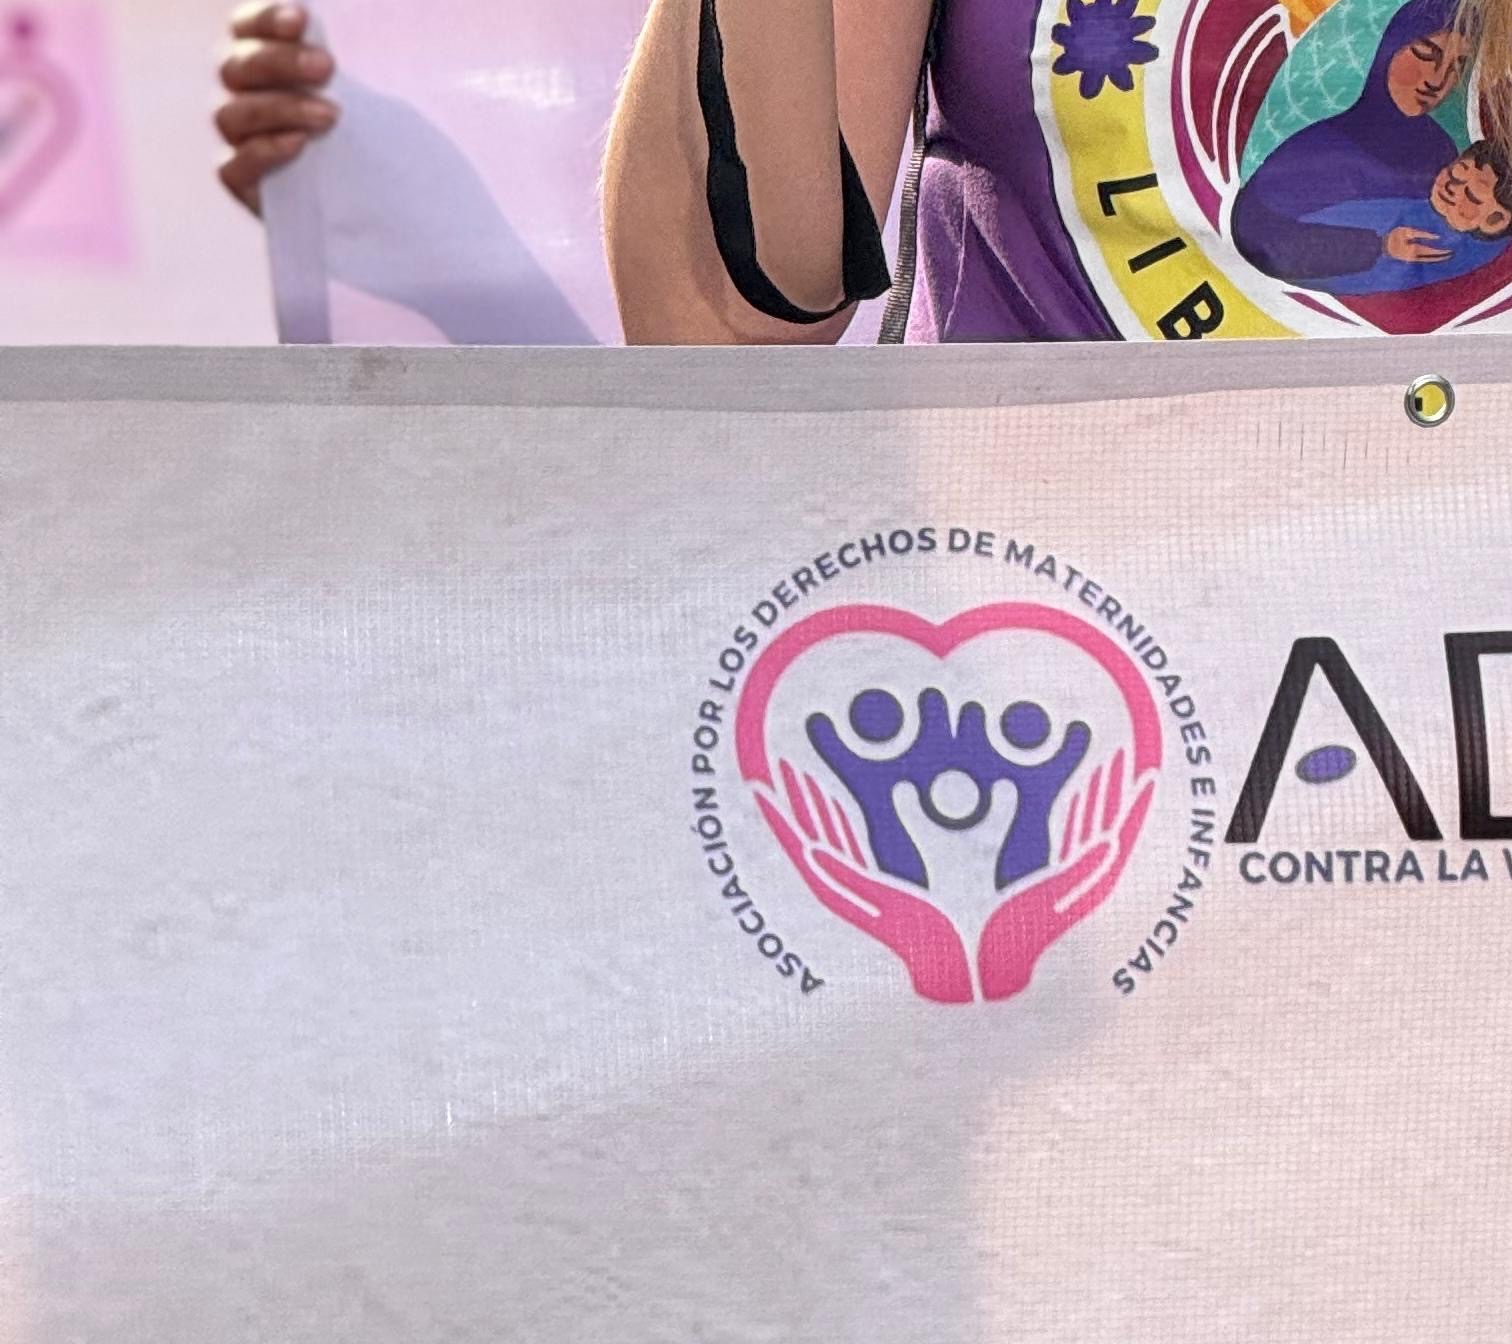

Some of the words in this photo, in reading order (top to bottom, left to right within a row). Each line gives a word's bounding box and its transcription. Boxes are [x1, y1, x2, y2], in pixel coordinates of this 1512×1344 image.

[752, 527, 937, 628] DERECHOS
[948, 528, 996, 558] DE
[708, 625, 759, 692] LOS
[1004, 539, 1212, 766] MATERNIDADES
[691, 699, 724, 774] POR
[1191, 776, 1216, 796] E
[690, 787, 825, 994] ASOCIACIÓN
[1112, 808, 1216, 995] INFANCIAS
[1239, 849, 1424, 883] CONTRA
[1437, 849, 1489, 882] LA
